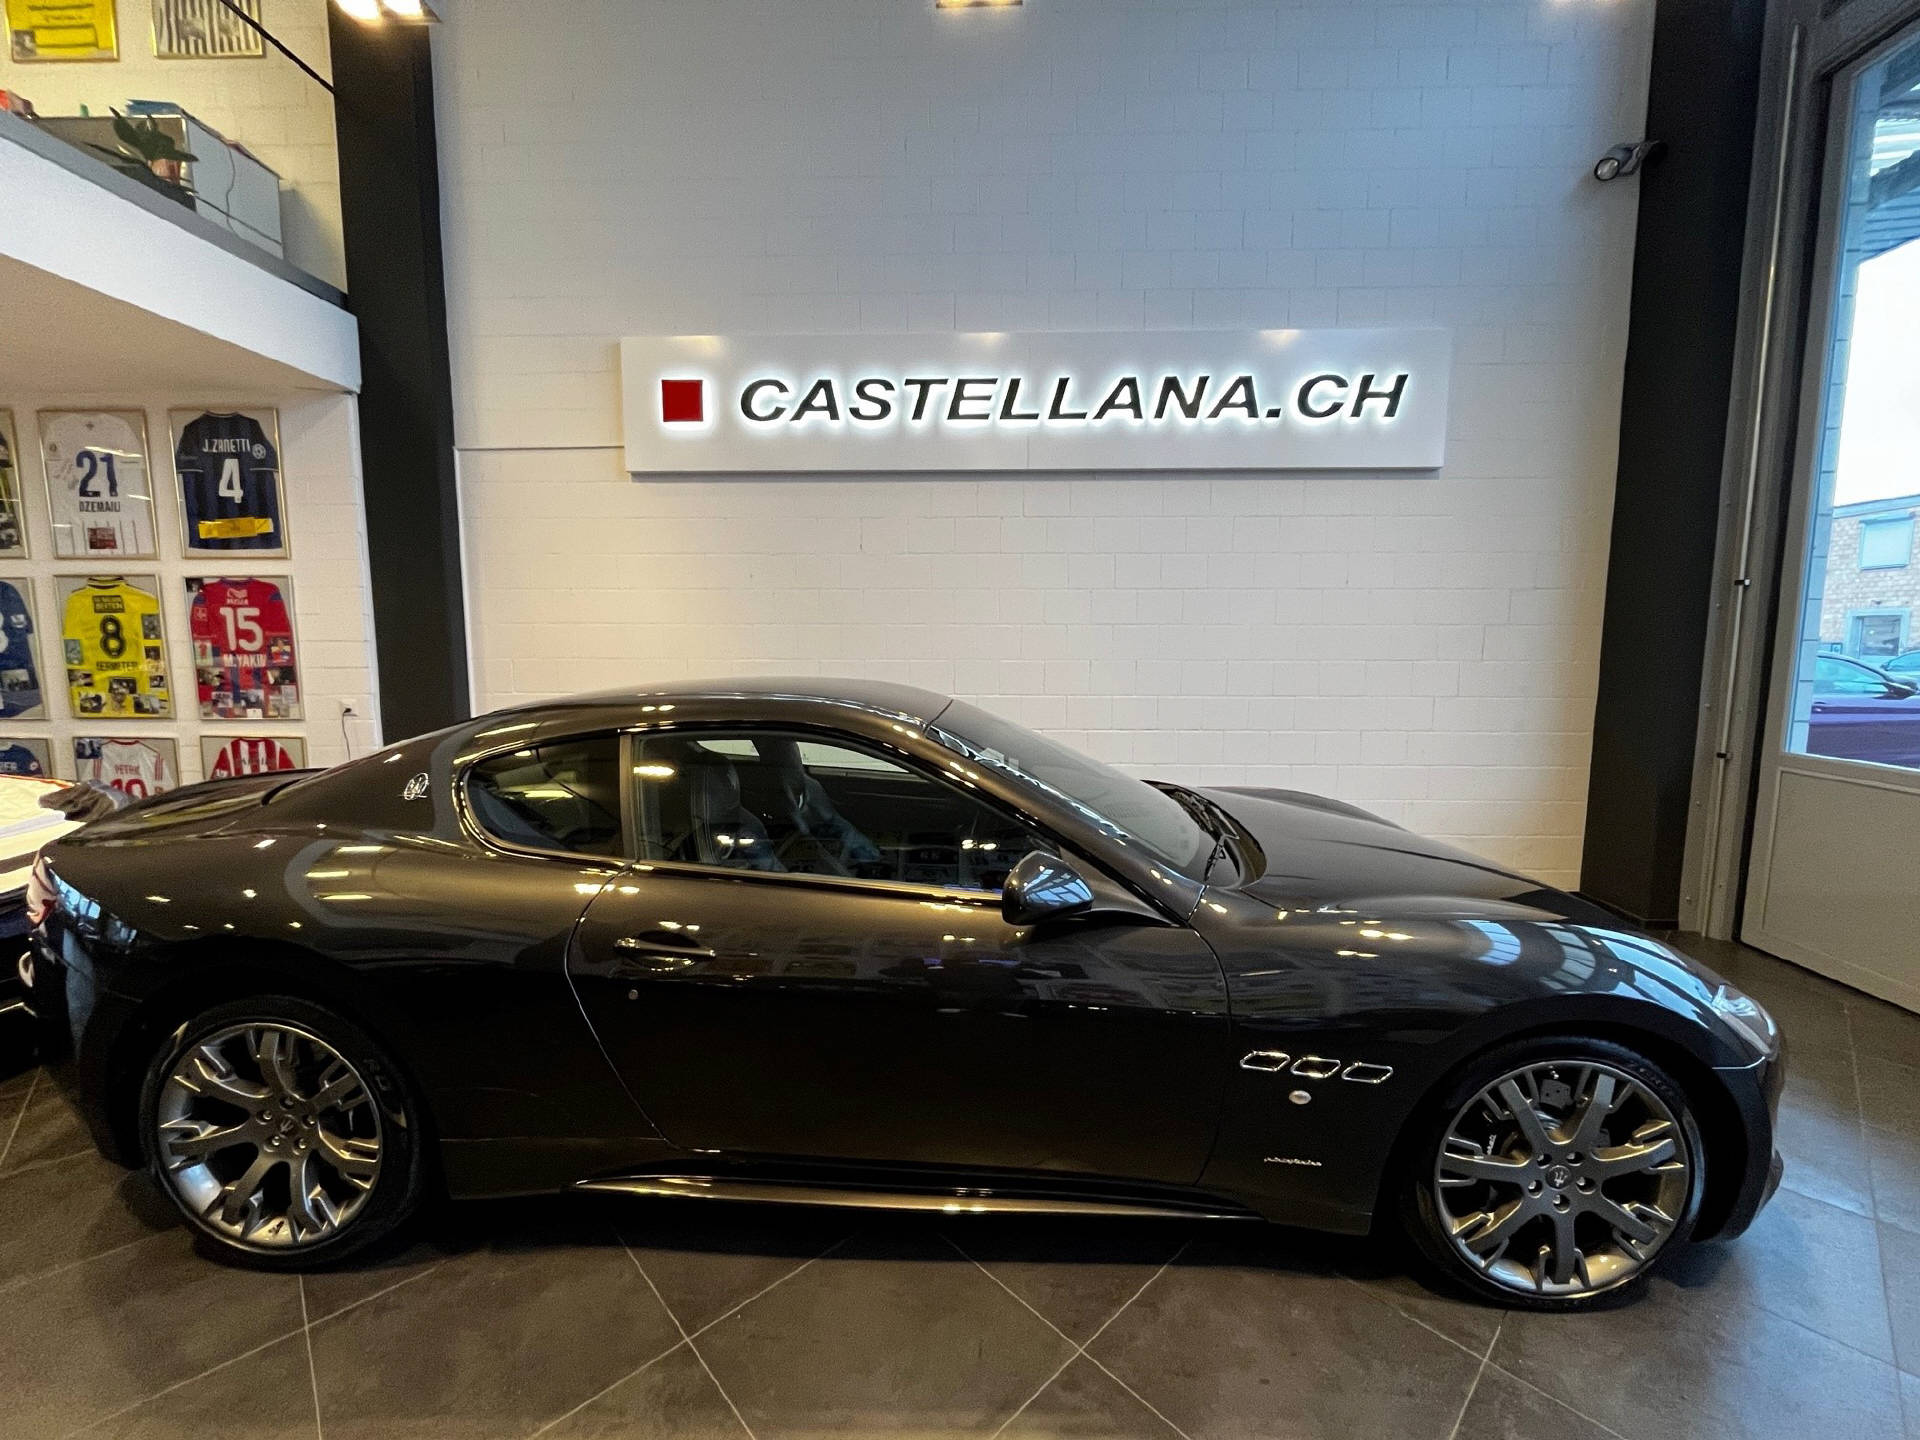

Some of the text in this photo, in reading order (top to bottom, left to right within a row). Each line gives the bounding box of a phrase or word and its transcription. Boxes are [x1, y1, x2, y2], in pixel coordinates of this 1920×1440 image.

[740, 373, 1408, 421] CASTELLANA.CH
[76, 450, 119, 497] 21
[219, 458, 243, 503] 4
[100, 615, 127, 658] 8
[219, 607, 263, 651] 15
